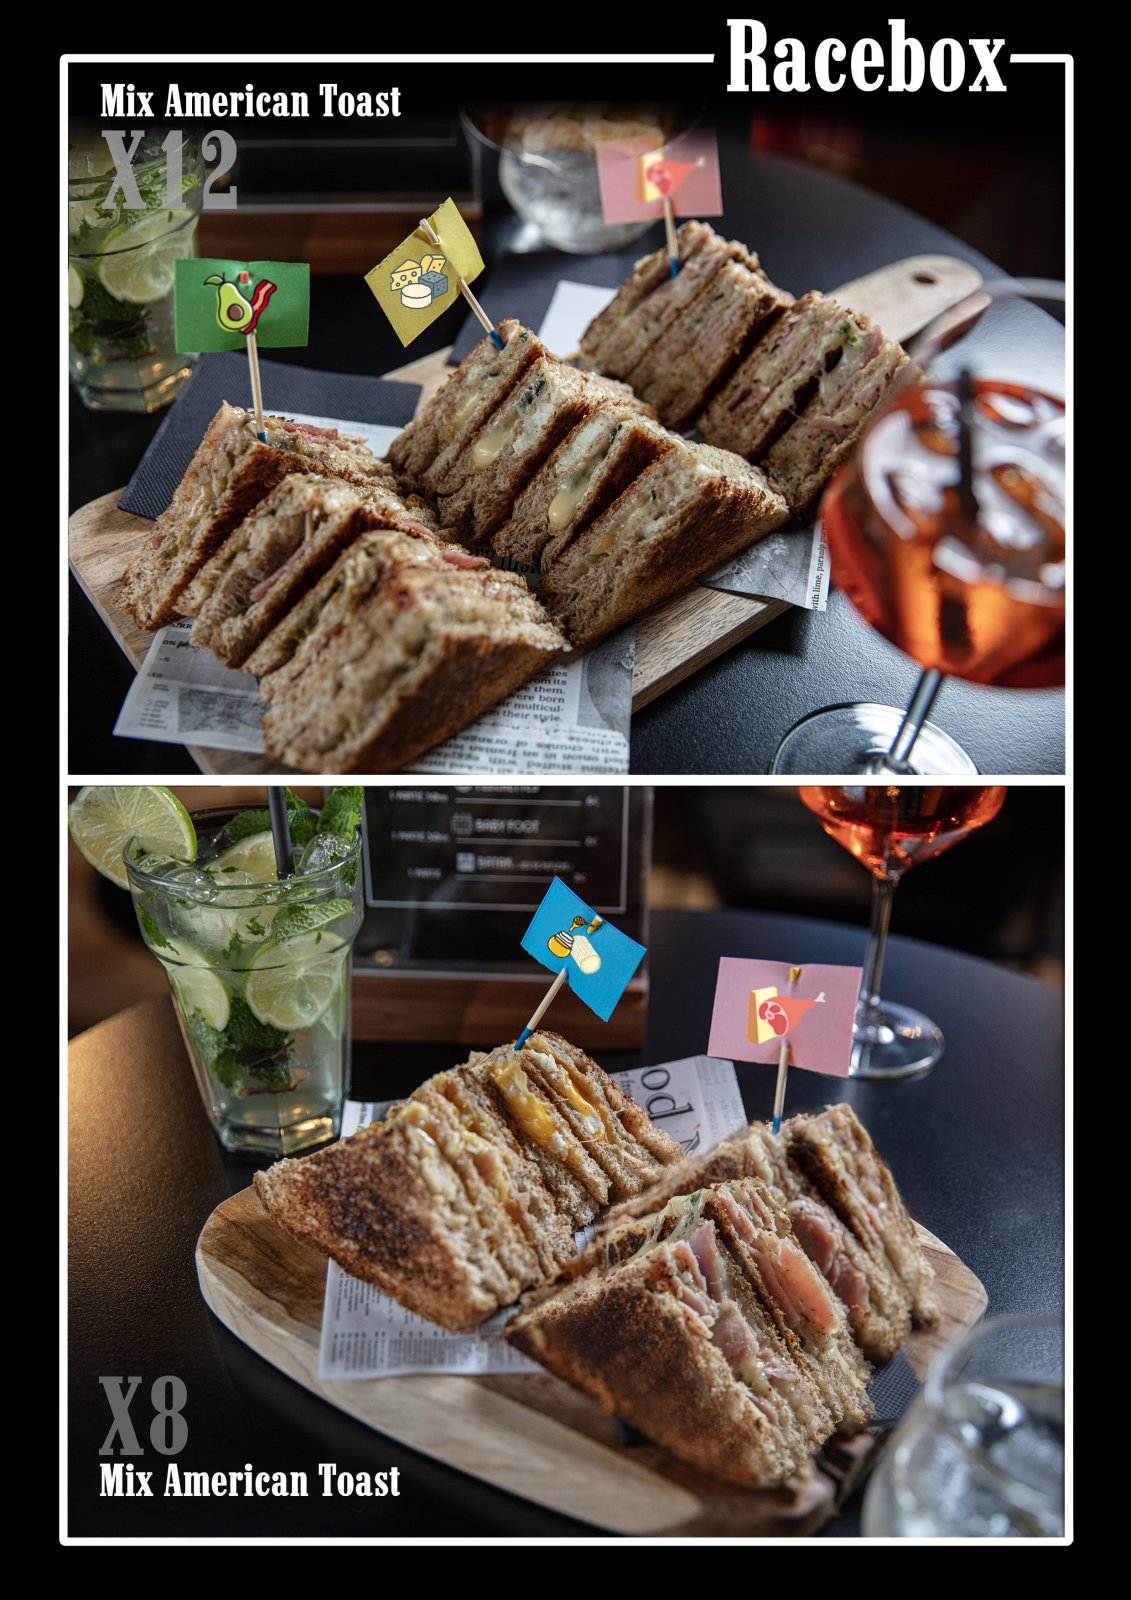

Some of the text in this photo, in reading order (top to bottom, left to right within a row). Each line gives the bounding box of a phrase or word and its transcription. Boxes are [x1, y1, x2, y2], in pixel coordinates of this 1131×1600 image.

[812, 573, 823, 593] lime,
[534, 685, 566, 695] them.
[539, 694, 565, 704] born
[514, 702, 564, 713] multicul-
